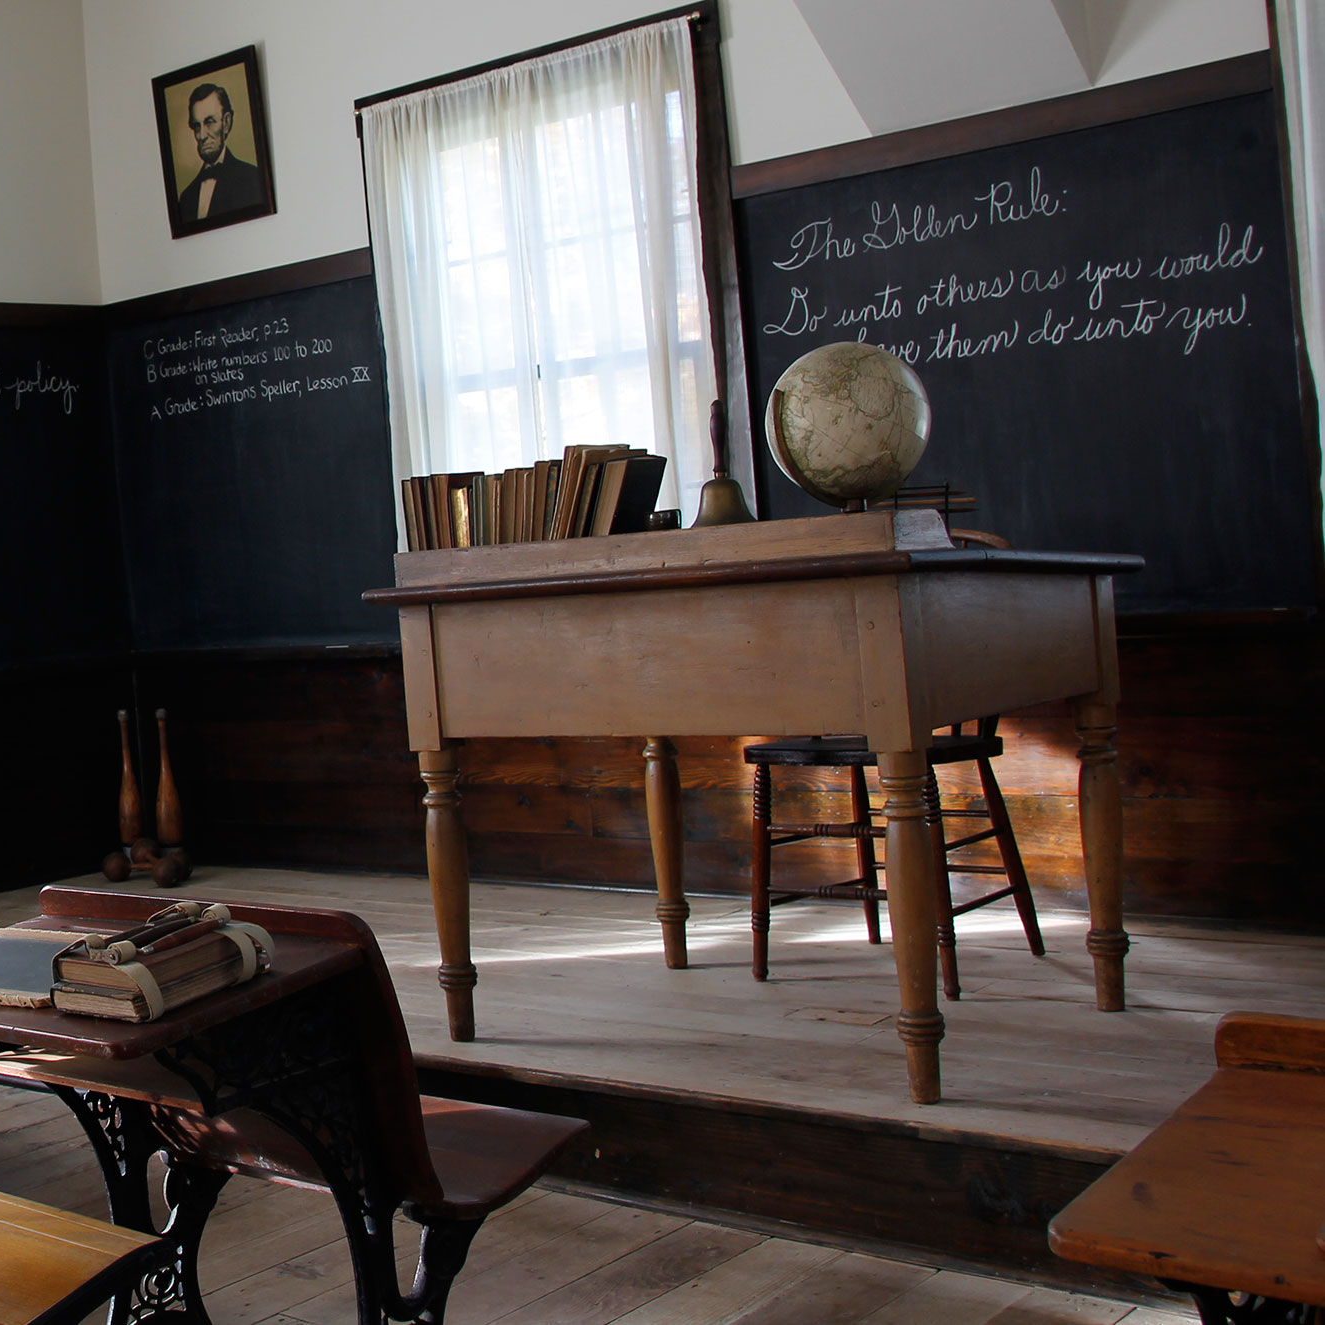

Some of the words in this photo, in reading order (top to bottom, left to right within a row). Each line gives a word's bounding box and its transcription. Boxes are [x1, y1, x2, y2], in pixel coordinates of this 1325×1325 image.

[773, 218, 855, 271] The
[863, 200, 977, 250] Golden
[975, 165, 1067, 225] Rule:
[763, 287, 826, 335] Do
[833, 283, 902, 327] unto
[916, 270, 1013, 315] others
[1021, 265, 1065, 292] as
[1075, 258, 1141, 310] you
[1151, 222, 1264, 280] would
[143, 340, 154, 360] C
[157, 337, 192, 355] Grade:
[194, 330, 216, 348] First
[220, 326, 259, 348] Reader,
[927, 319, 1019, 363] them
[1028, 308, 1075, 346] do
[1074, 296, 1165, 342] unto
[147, 364, 157, 383] B
[159, 359, 192, 378] Grade:
[193, 356, 217, 372] Write
[221, 350, 267, 367] numbers
[274, 346, 290, 361] 100
[294, 342, 307, 357] to
[312, 339, 332, 355] 200
[196, 372, 208, 385] on
[211, 368, 244, 384] slates
[151, 405, 162, 421] A
[165, 396, 203, 416] Grade:
[205, 385, 256, 407] Swinton's
[260, 379, 302, 402] Speller,
[307, 374, 348, 392] Lesson
[351, 367, 371, 383] XX
